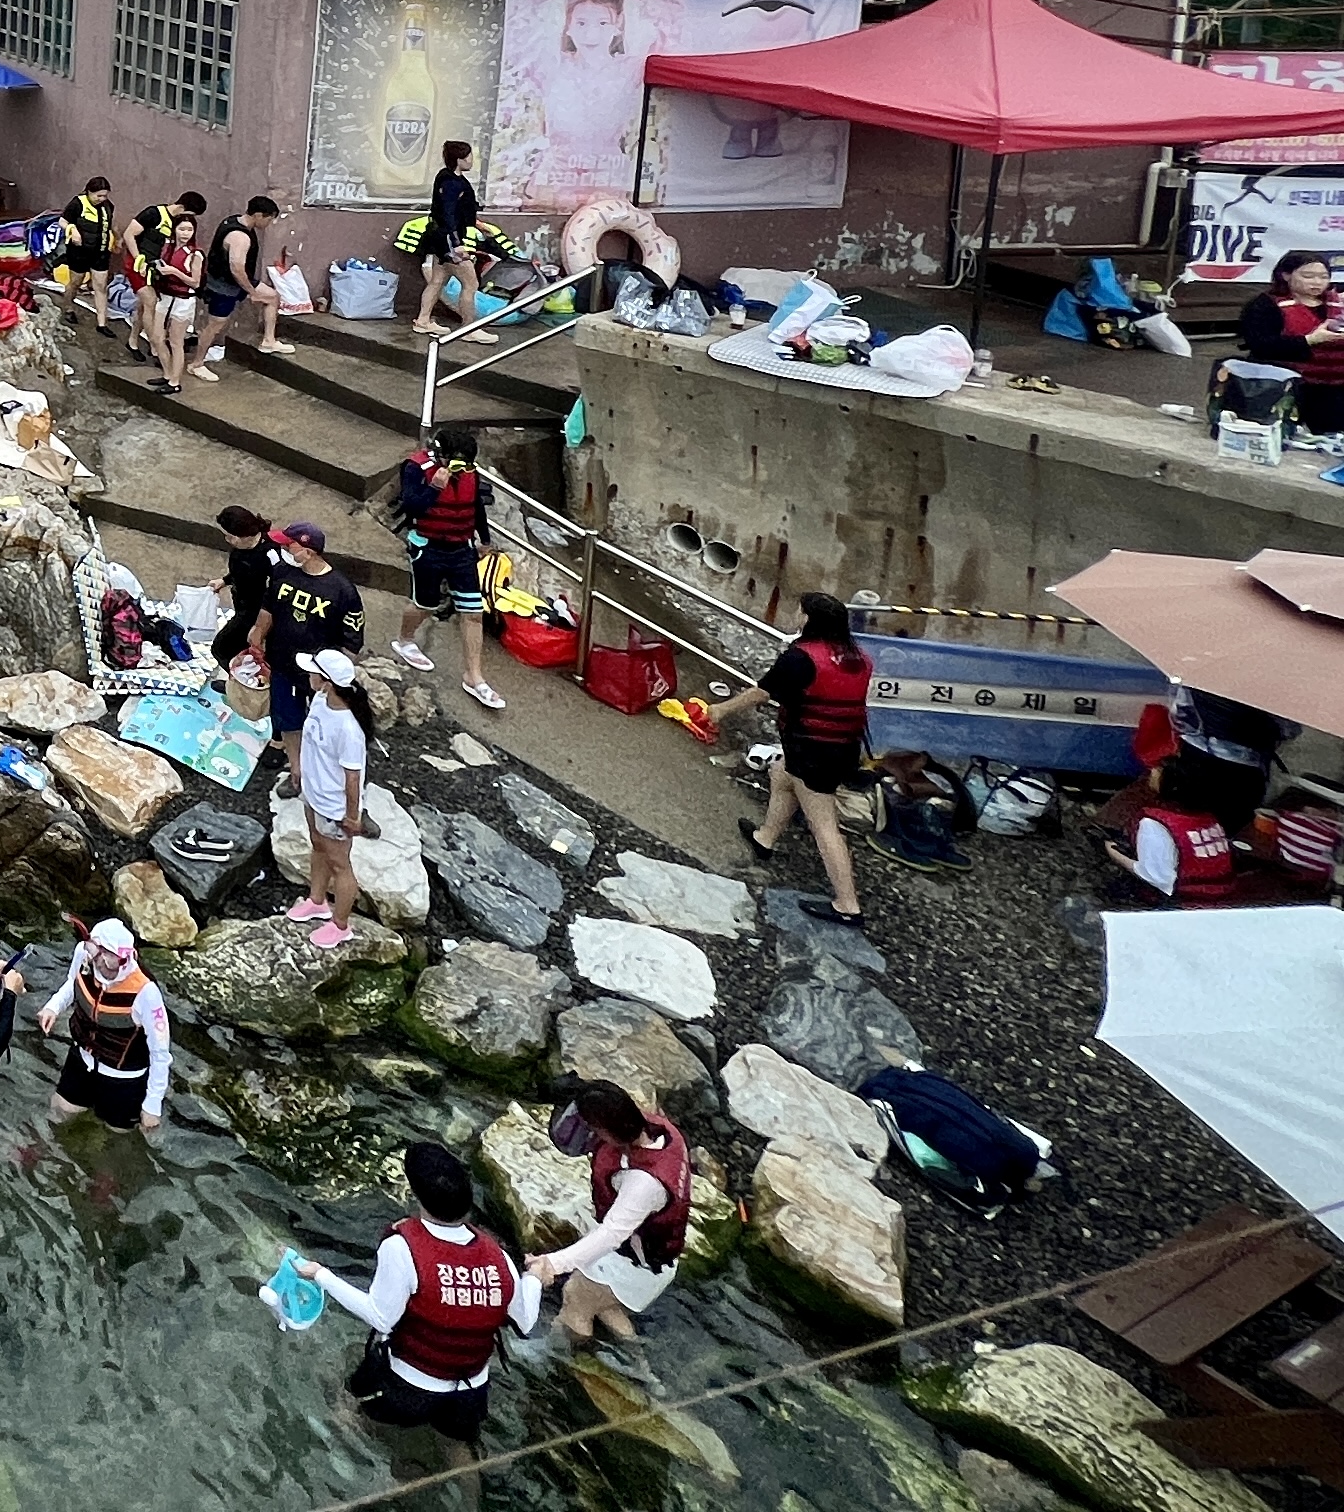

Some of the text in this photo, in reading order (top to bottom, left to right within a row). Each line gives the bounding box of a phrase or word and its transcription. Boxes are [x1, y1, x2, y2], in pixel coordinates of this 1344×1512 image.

[388, 121, 427, 135] TERRA
[313, 181, 369, 201] TERRA
[1191, 205, 1216, 220] BIG
[1188, 225, 1269, 263] DIVE
[277, 583, 331, 619] FOX
[877, 681, 1097, 716] 안전 제일
[436, 1263, 502, 1287] 장호어촌
[440, 1286, 502, 1307] 체험마을
